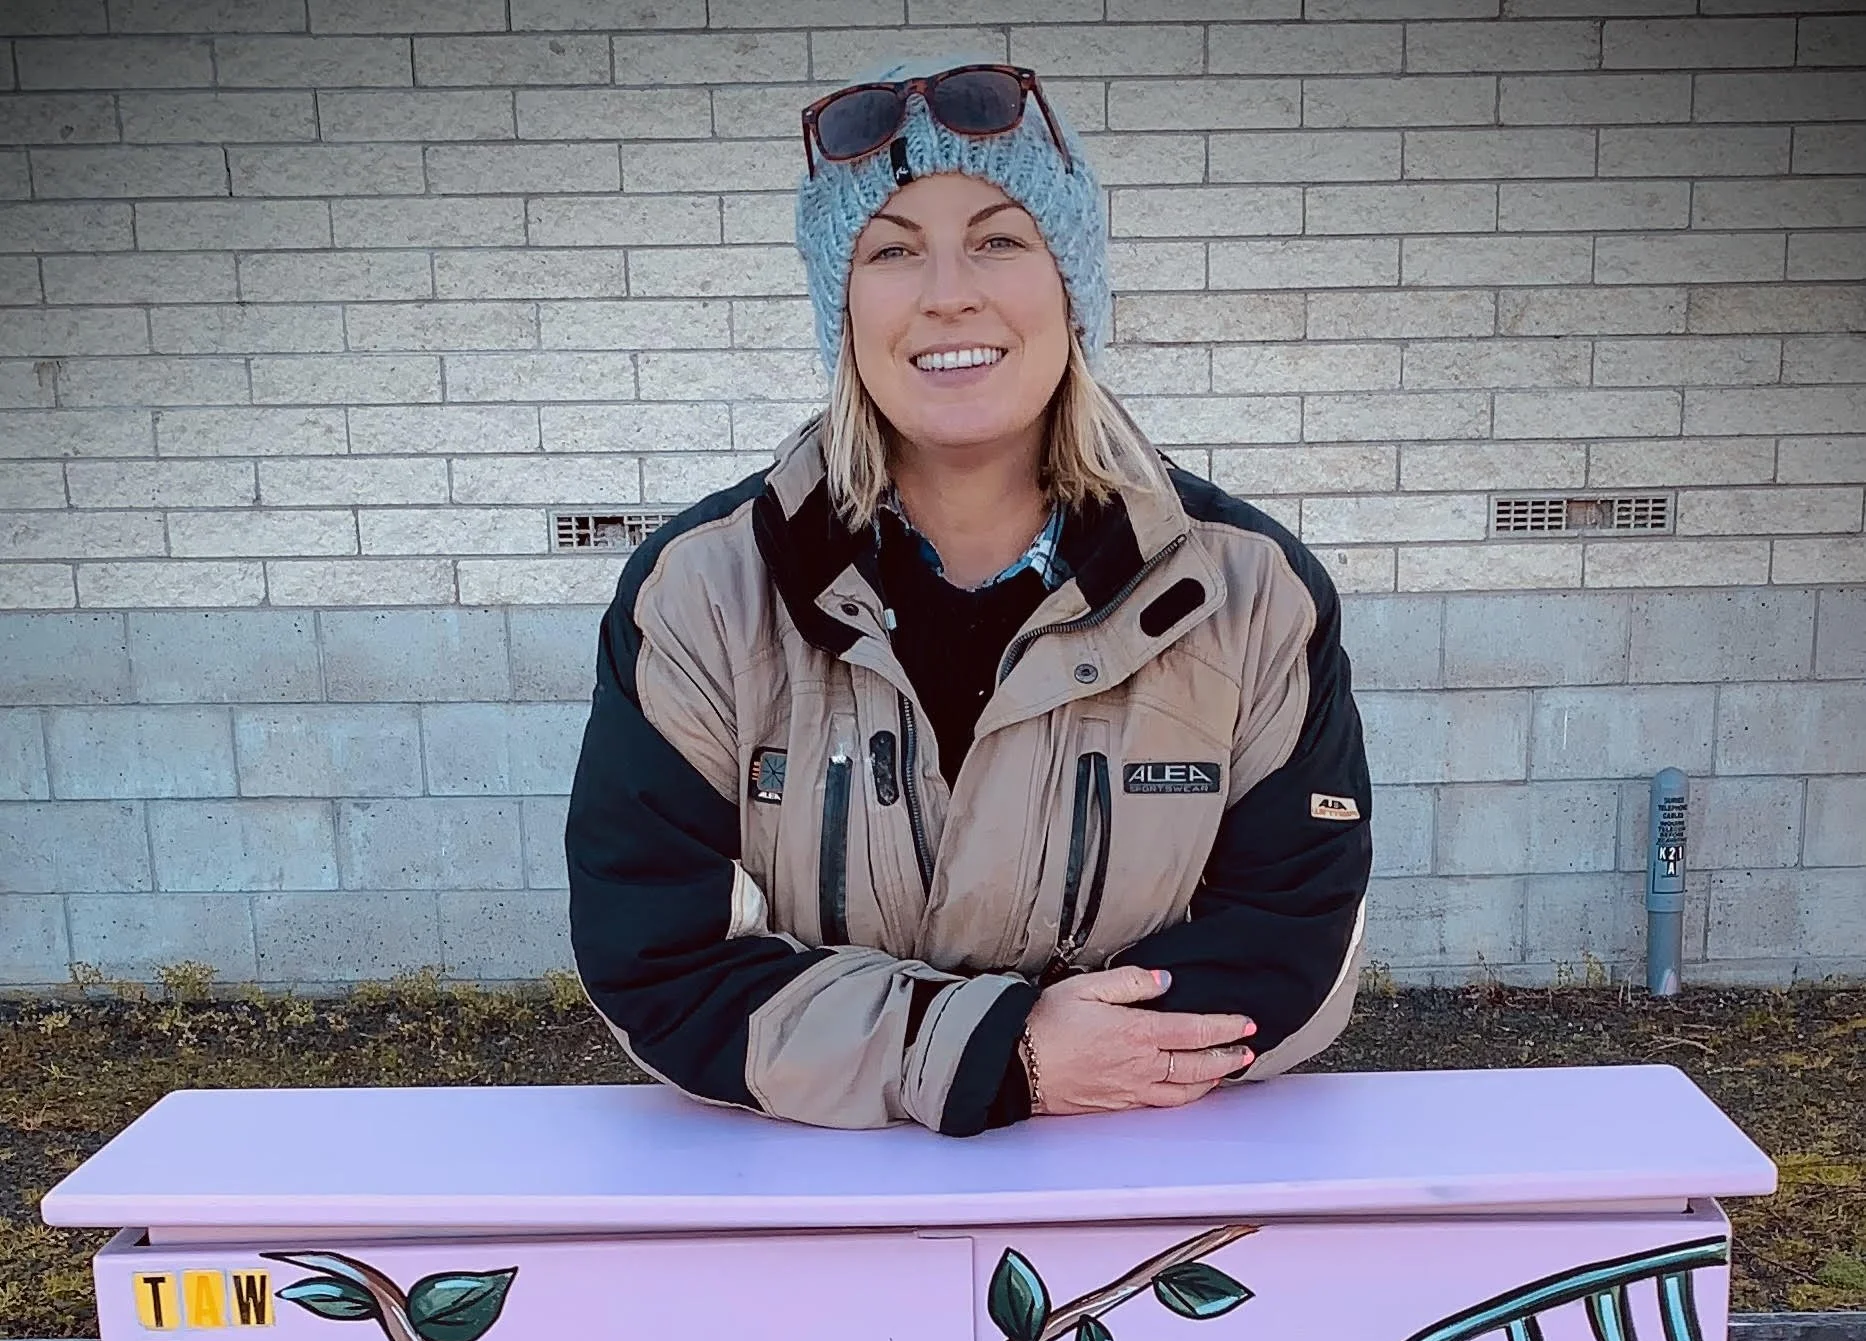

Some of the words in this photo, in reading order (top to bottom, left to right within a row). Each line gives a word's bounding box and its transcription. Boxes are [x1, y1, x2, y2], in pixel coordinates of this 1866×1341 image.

[1128, 765, 1212, 782] ALEA
[1129, 783, 1209, 793] SPORTSWEAR
[1659, 846, 1683, 860] K21
[1667, 862, 1675, 875] A
